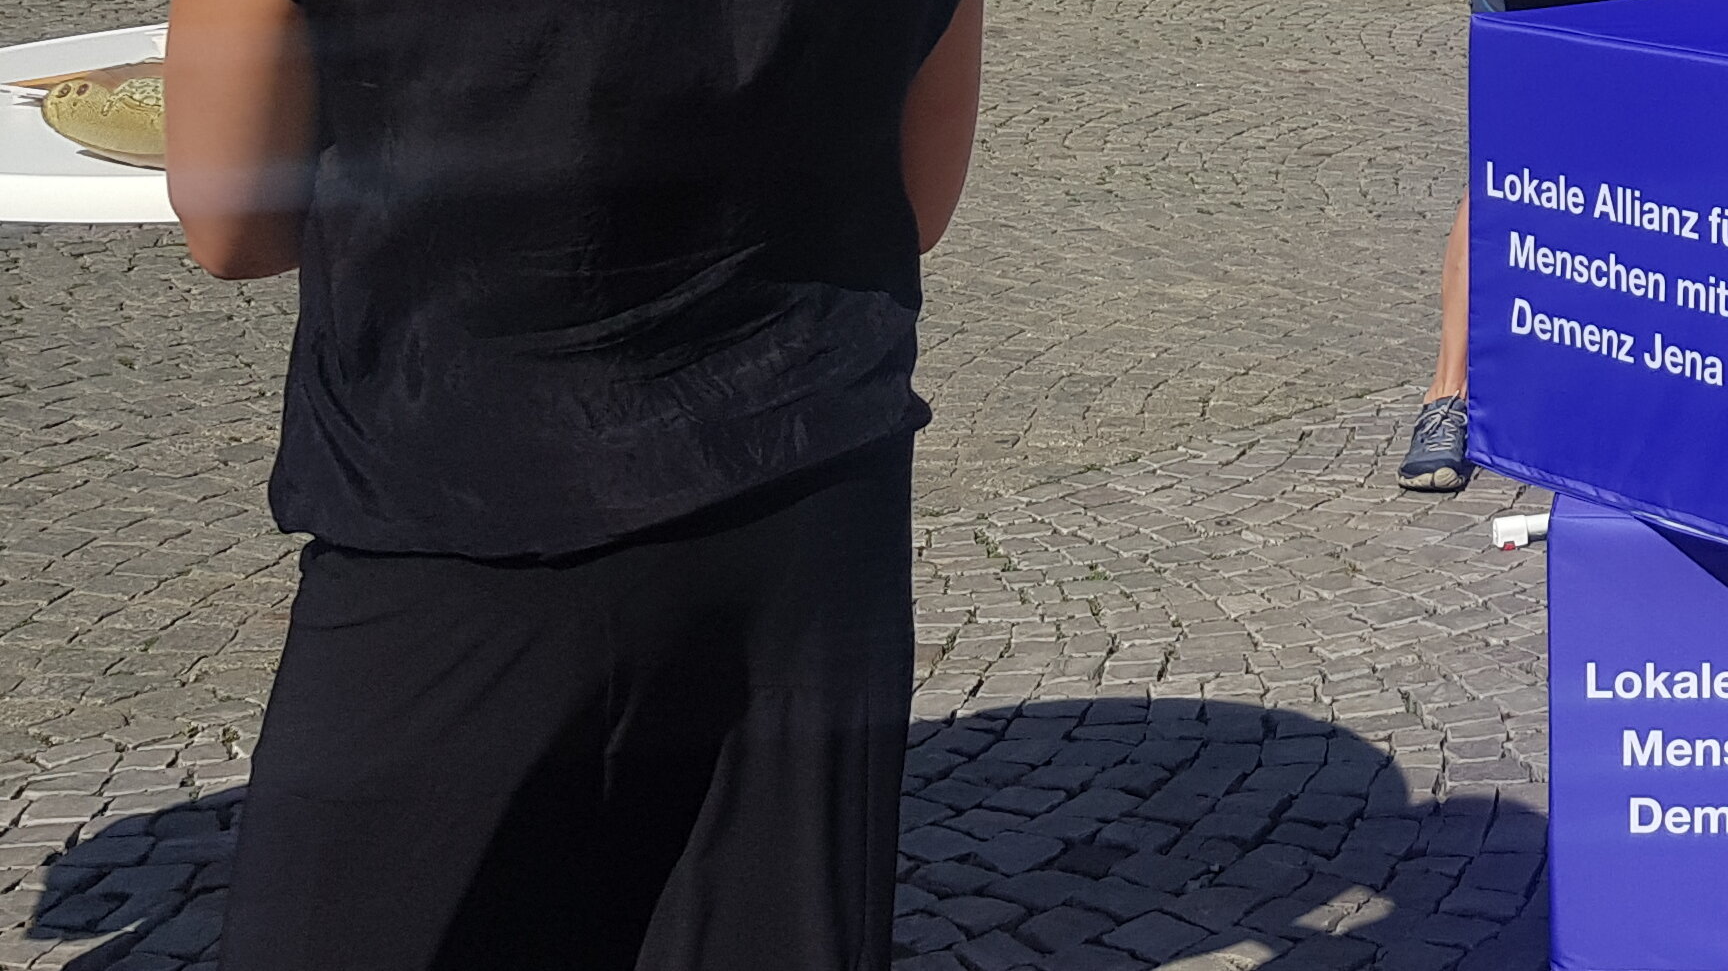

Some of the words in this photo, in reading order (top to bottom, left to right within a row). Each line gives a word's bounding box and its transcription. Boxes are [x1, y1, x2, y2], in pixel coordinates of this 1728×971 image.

[1485, 160, 1585, 215] Lokale
[1593, 182, 1700, 240] Allianz
[1508, 230, 1666, 302] Menschen
[1510, 297, 1635, 364] Demenz
[1643, 332, 1724, 387] Jena
